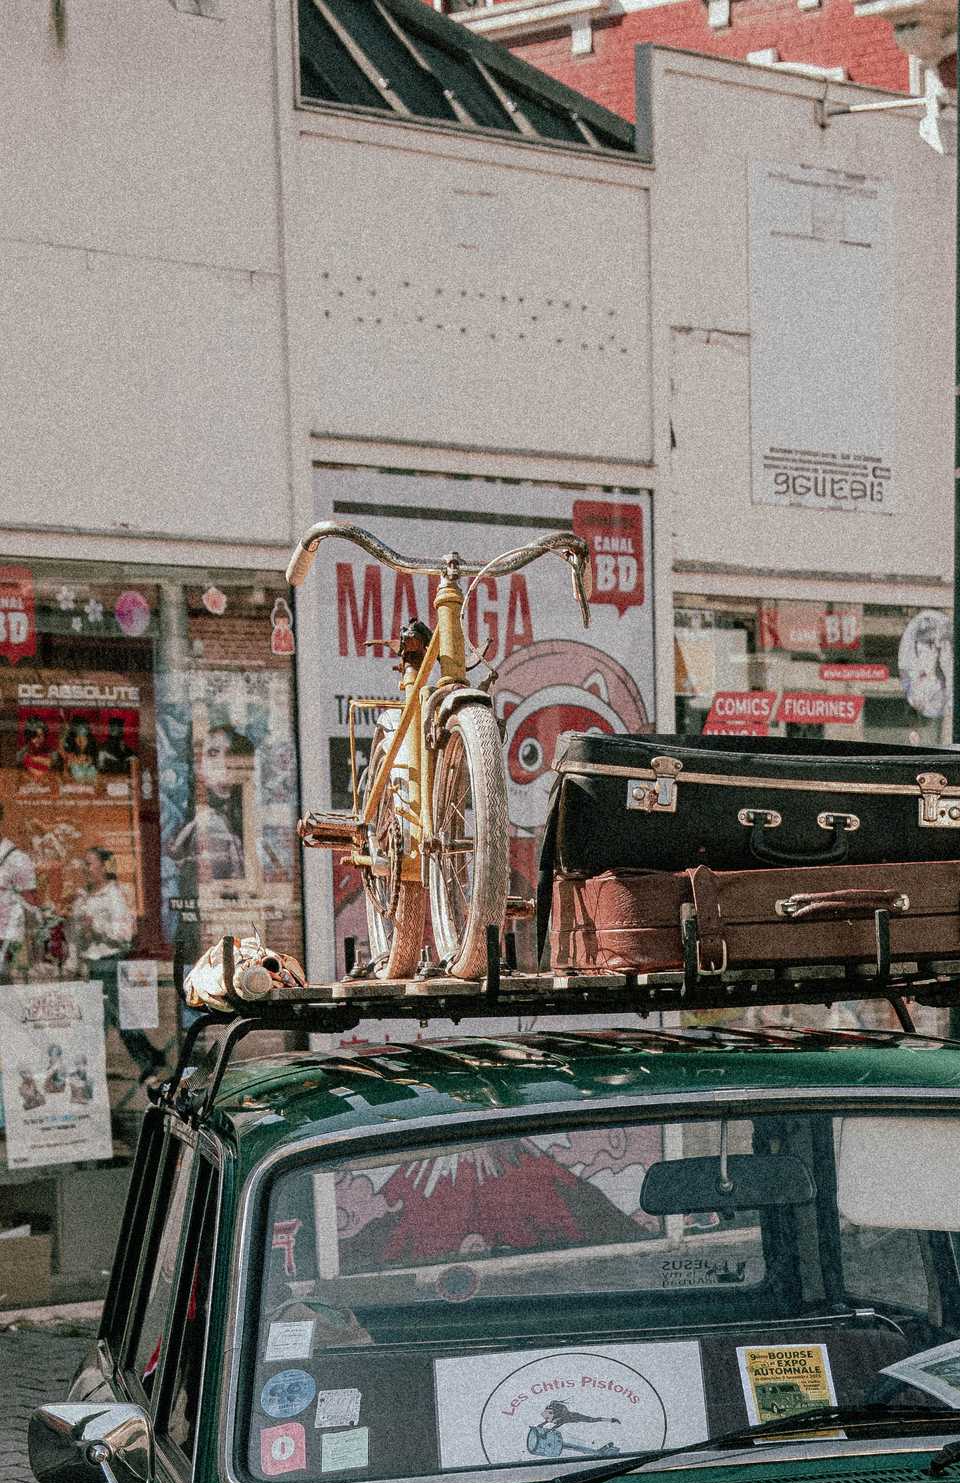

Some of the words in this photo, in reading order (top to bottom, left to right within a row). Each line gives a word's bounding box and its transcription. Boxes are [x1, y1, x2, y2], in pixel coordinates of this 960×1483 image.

[594, 535, 634, 552] CANAL
[595, 554, 637, 592] BD
[336, 562, 534, 662] MAGA
[825, 615, 857, 644] BD
[18, 684, 44, 698] DC
[48, 685, 140, 700] ABSOLUTE
[715, 697, 770, 717] COMICS
[784, 698, 855, 719] FIGURINES
[768, 1351, 813, 1360] BOURSE
[777, 1359, 807, 1367] EXPO
[754, 1366, 822, 1376] AUTOMNALE
[502, 1390, 529, 1416] Les
[580, 1373, 642, 1406] Pistons
